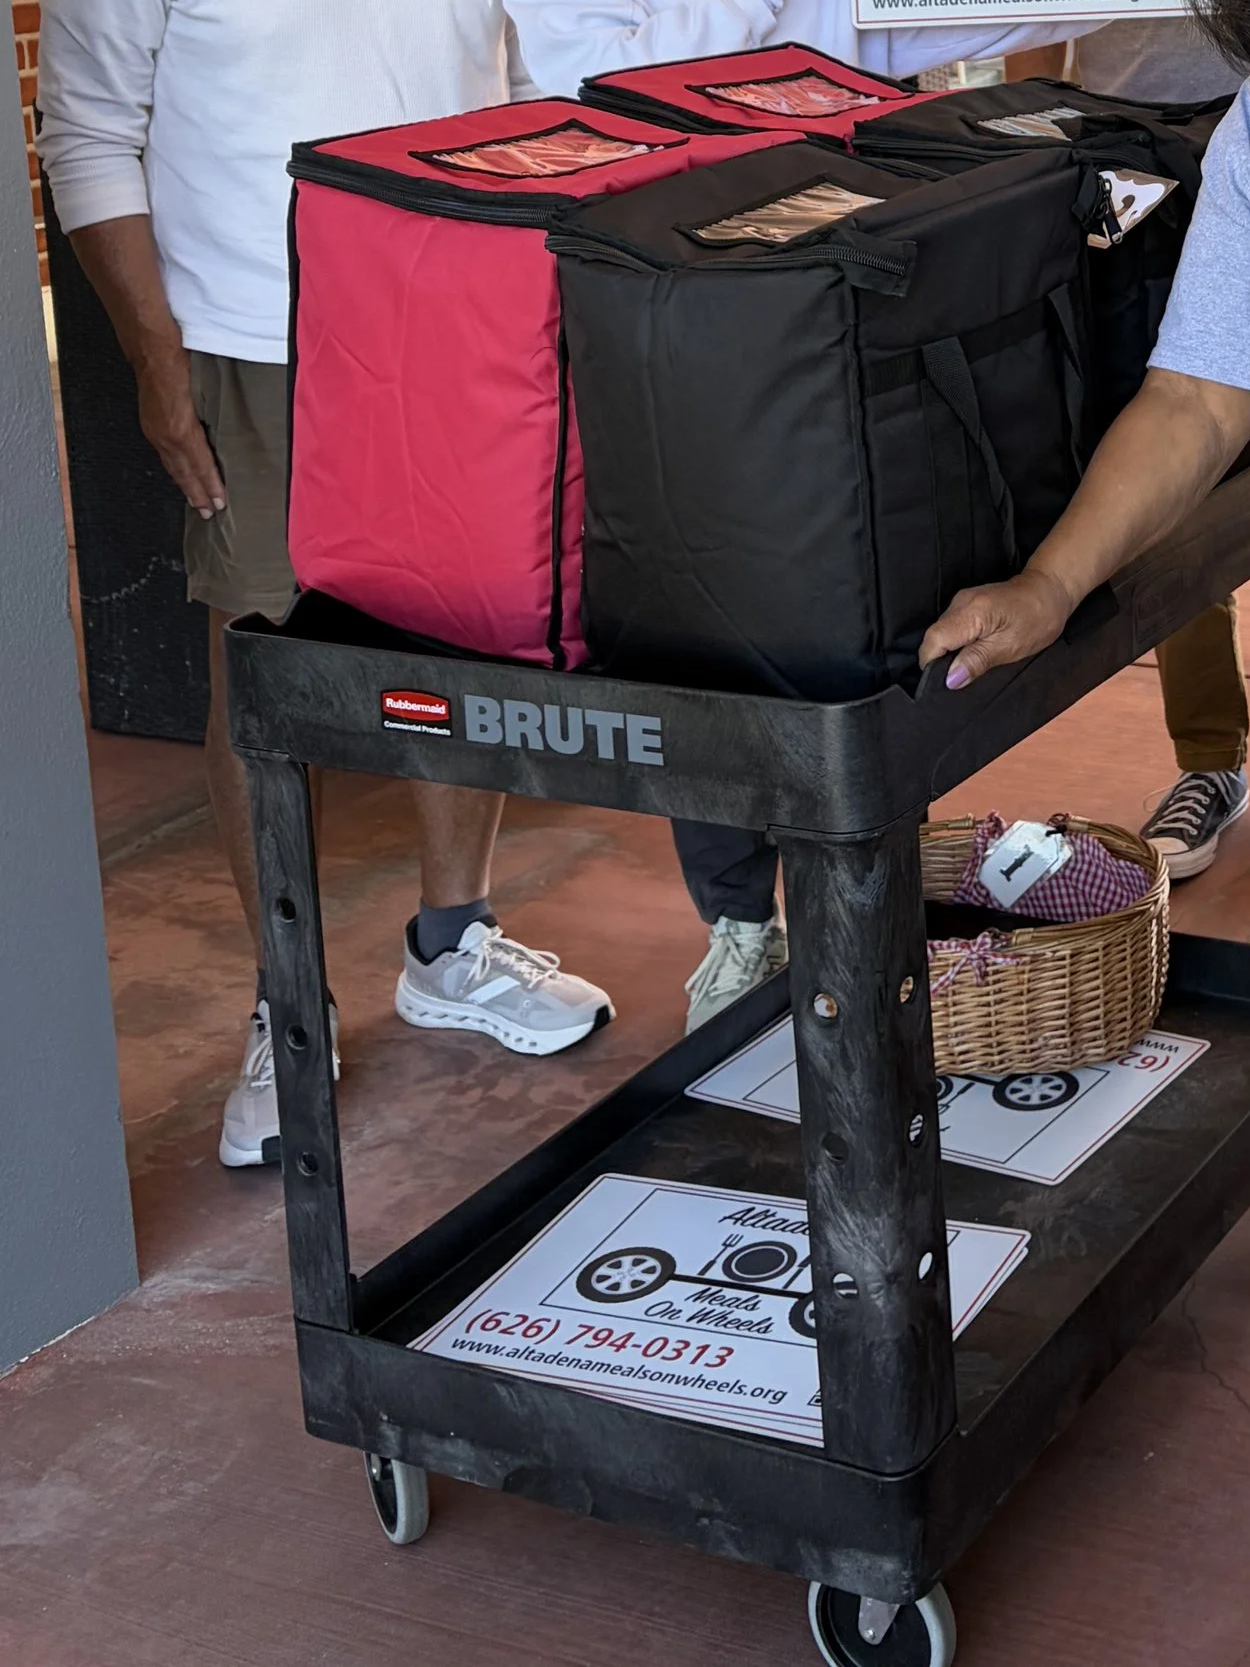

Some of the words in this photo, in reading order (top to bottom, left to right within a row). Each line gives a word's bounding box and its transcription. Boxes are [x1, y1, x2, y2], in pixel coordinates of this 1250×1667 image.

[385, 697, 446, 715] Rubbermaid
[384, 720, 421, 732] Commercial
[422, 725, 451, 736] Products
[464, 694, 664, 766] BRUTE
[684, 1287, 762, 1312] Meals
[644, 1300, 683, 1320] On
[686, 1307, 775, 1334] Wheels
[465, 1308, 561, 1345] (626)
[564, 1323, 735, 1369] 794-0313
[451, 1336, 789, 1405] www.altadenamealsonwheels.org
